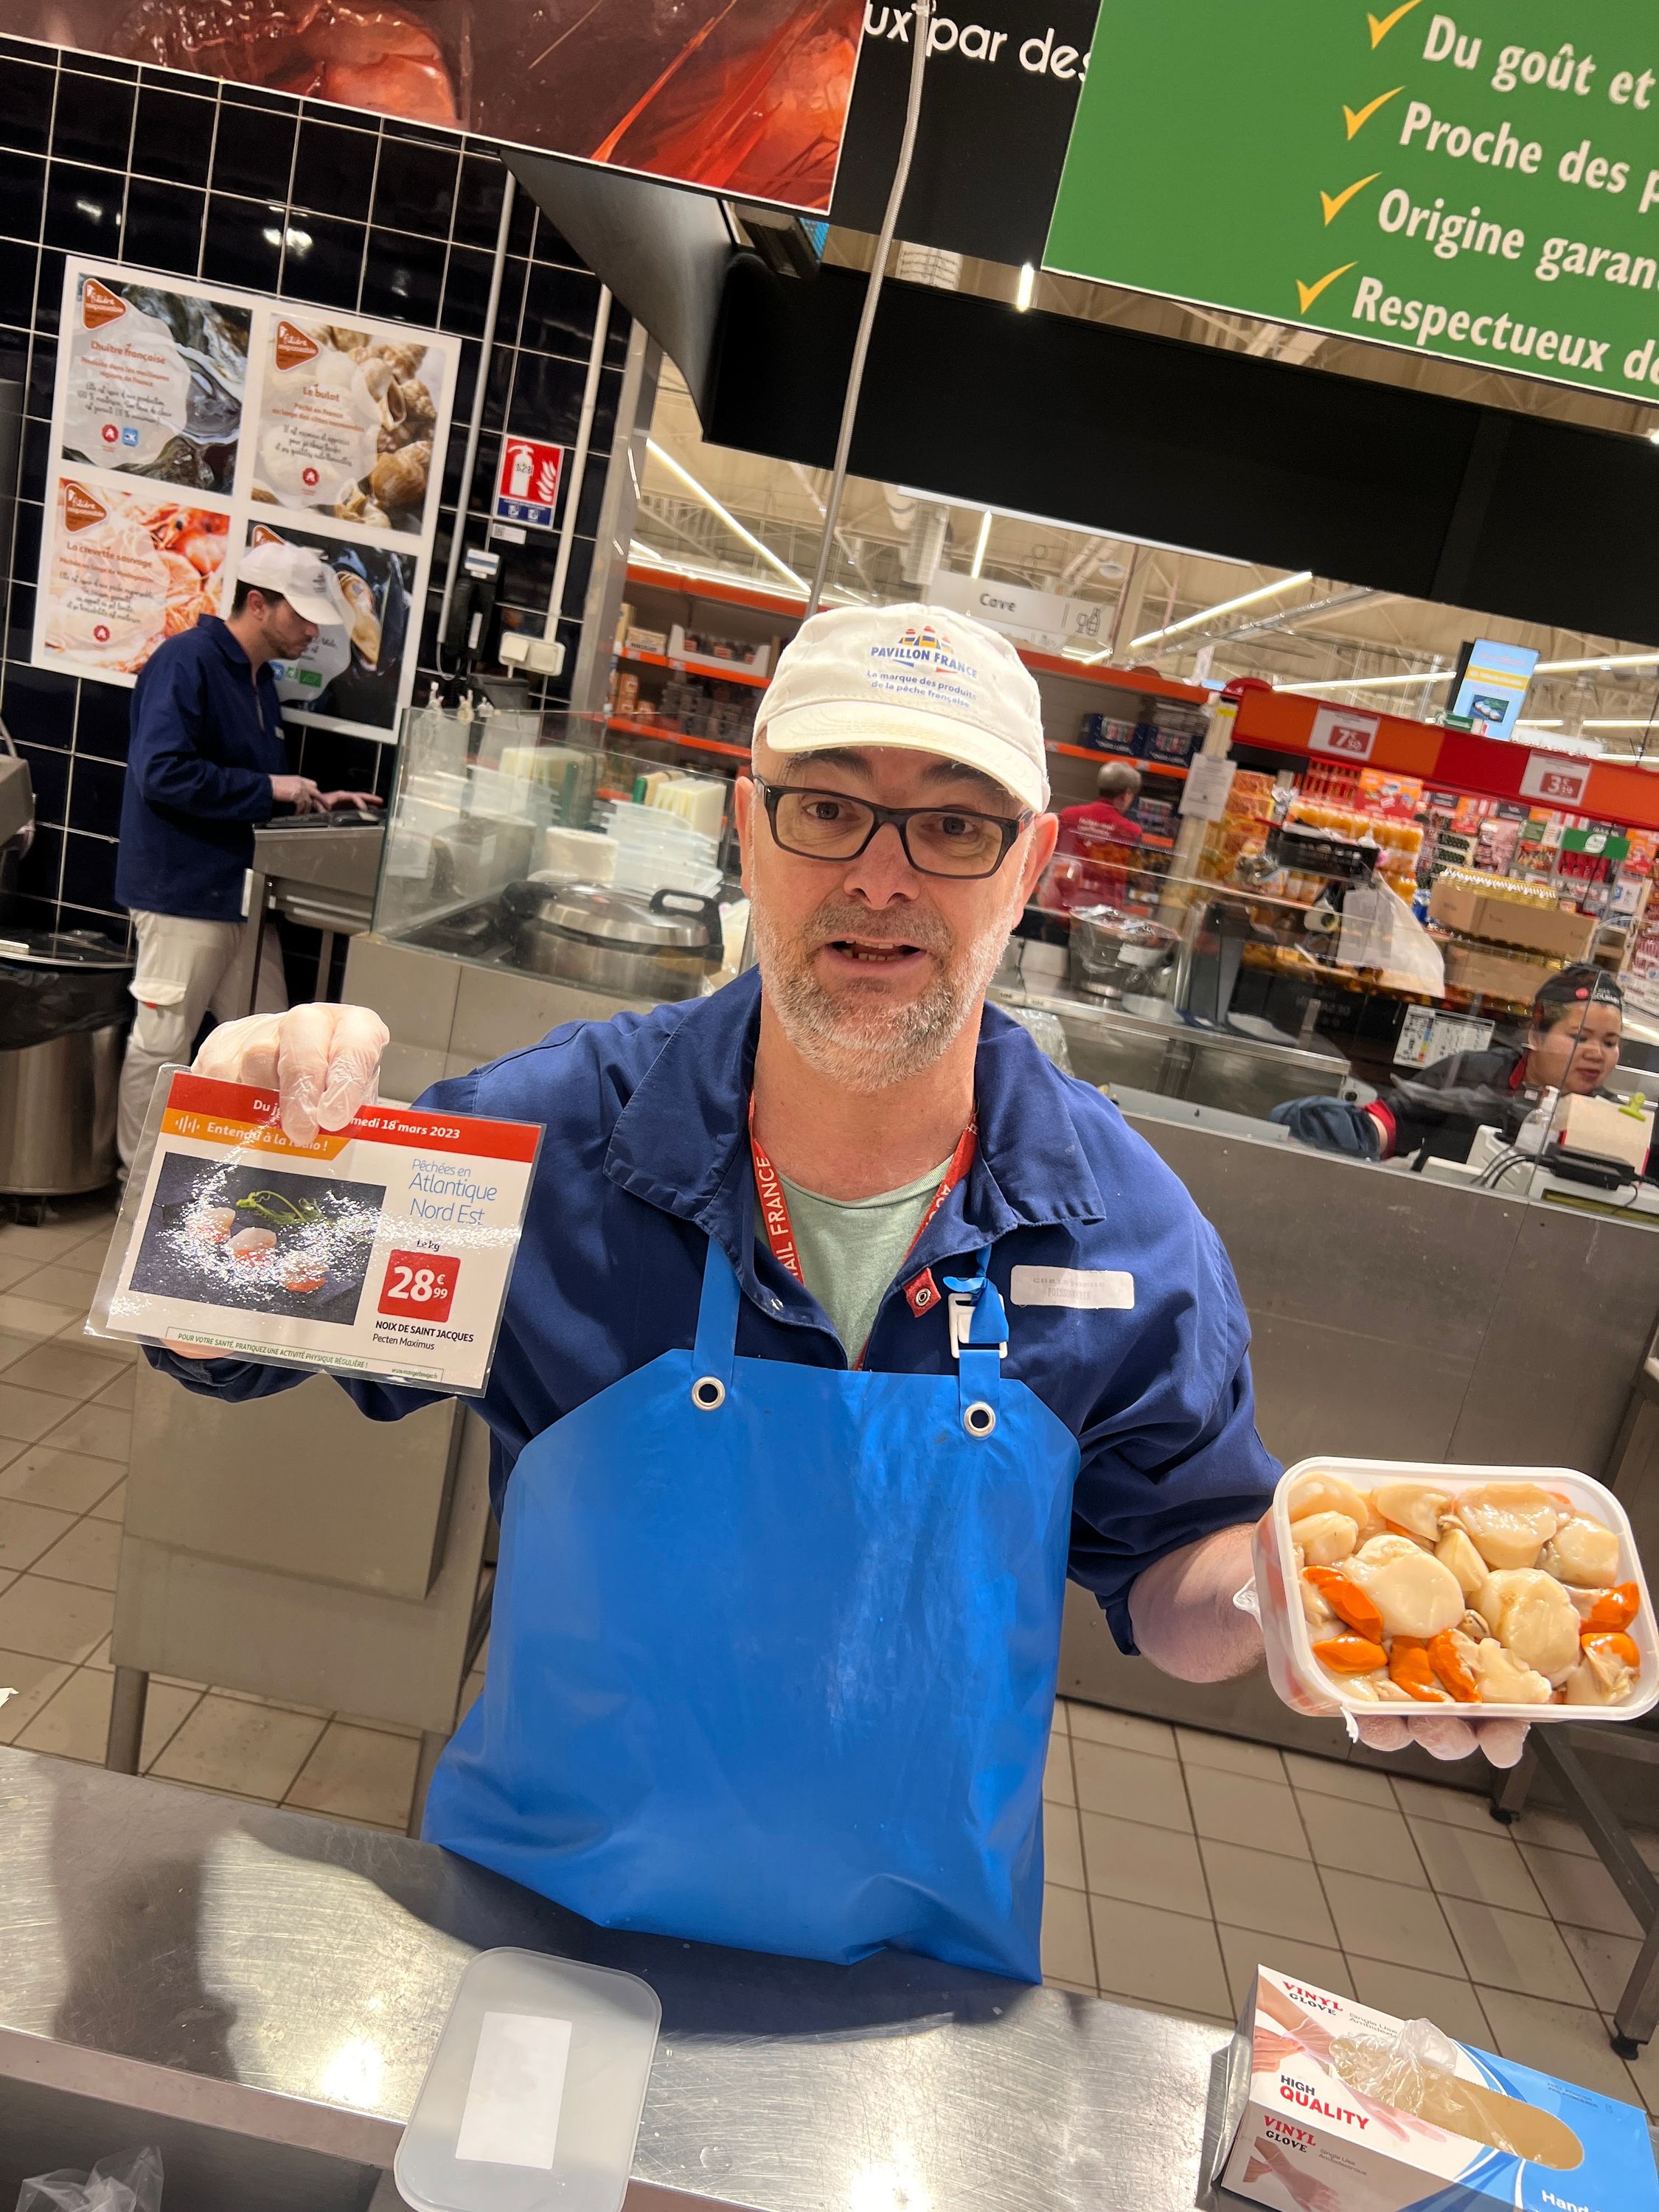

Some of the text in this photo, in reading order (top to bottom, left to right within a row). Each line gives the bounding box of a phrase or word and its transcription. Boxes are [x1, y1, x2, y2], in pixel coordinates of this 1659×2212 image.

[925, 16, 1008, 61] par
[1422, 14, 1657, 110] Du goût et
[1399, 101, 1543, 174] Proche
[1558, 140, 1631, 194] des
[1378, 188, 1659, 290] Origine garan
[1352, 276, 1610, 372] Respectueux
[978, 592, 1017, 613] Cave
[933, 652, 978, 679] FRANCE
[867, 669, 977, 700] La marque des produits
[872, 681, 883, 689] de
[896, 682, 926, 696] pêche
[928, 690, 970, 708] française
[253, 1099, 271, 1111] Du
[349, 1117, 381, 1129] medi
[382, 1119, 397, 1130] 18
[397, 1122, 428, 1135] mars
[430, 1126, 462, 1139] 2023
[263, 1132, 271, 1143] à
[274, 1135, 286, 1146] la
[411, 1158, 471, 1177] Pêchées en
[408, 1172, 498, 1203] Atlantique
[756, 1156, 789, 1237] FRANCE
[410, 1197, 485, 1225] Nord Est
[387, 1265, 448, 1302] 28 € 99
[372, 1333, 435, 1350] Pecten Maximus
[375, 1321, 474, 1342] NOIX DE SAINT JACQUES
[178, 1333, 195, 1341] POUR
[195, 1336, 214, 1345] VOTRE
[235, 1342, 267, 1353] PRATIQUEZ
[268, 1347, 279, 1355] UNE
[279, 1349, 305, 1359] ACTIVITÉ
[305, 1353, 334, 1364] PHYSIQUE
[1282, 1980, 1343, 2011] VINYL
[1289, 1992, 1337, 2017] GLOVE
[1281, 2074, 1315, 2096] HIGH
[1280, 2085, 1369, 2129] QUALITY
[1264, 2115, 1316, 2146] VINYL
[1266, 2130, 1308, 2153] GLOVE
[1541, 2189, 1589, 2212] Hand
